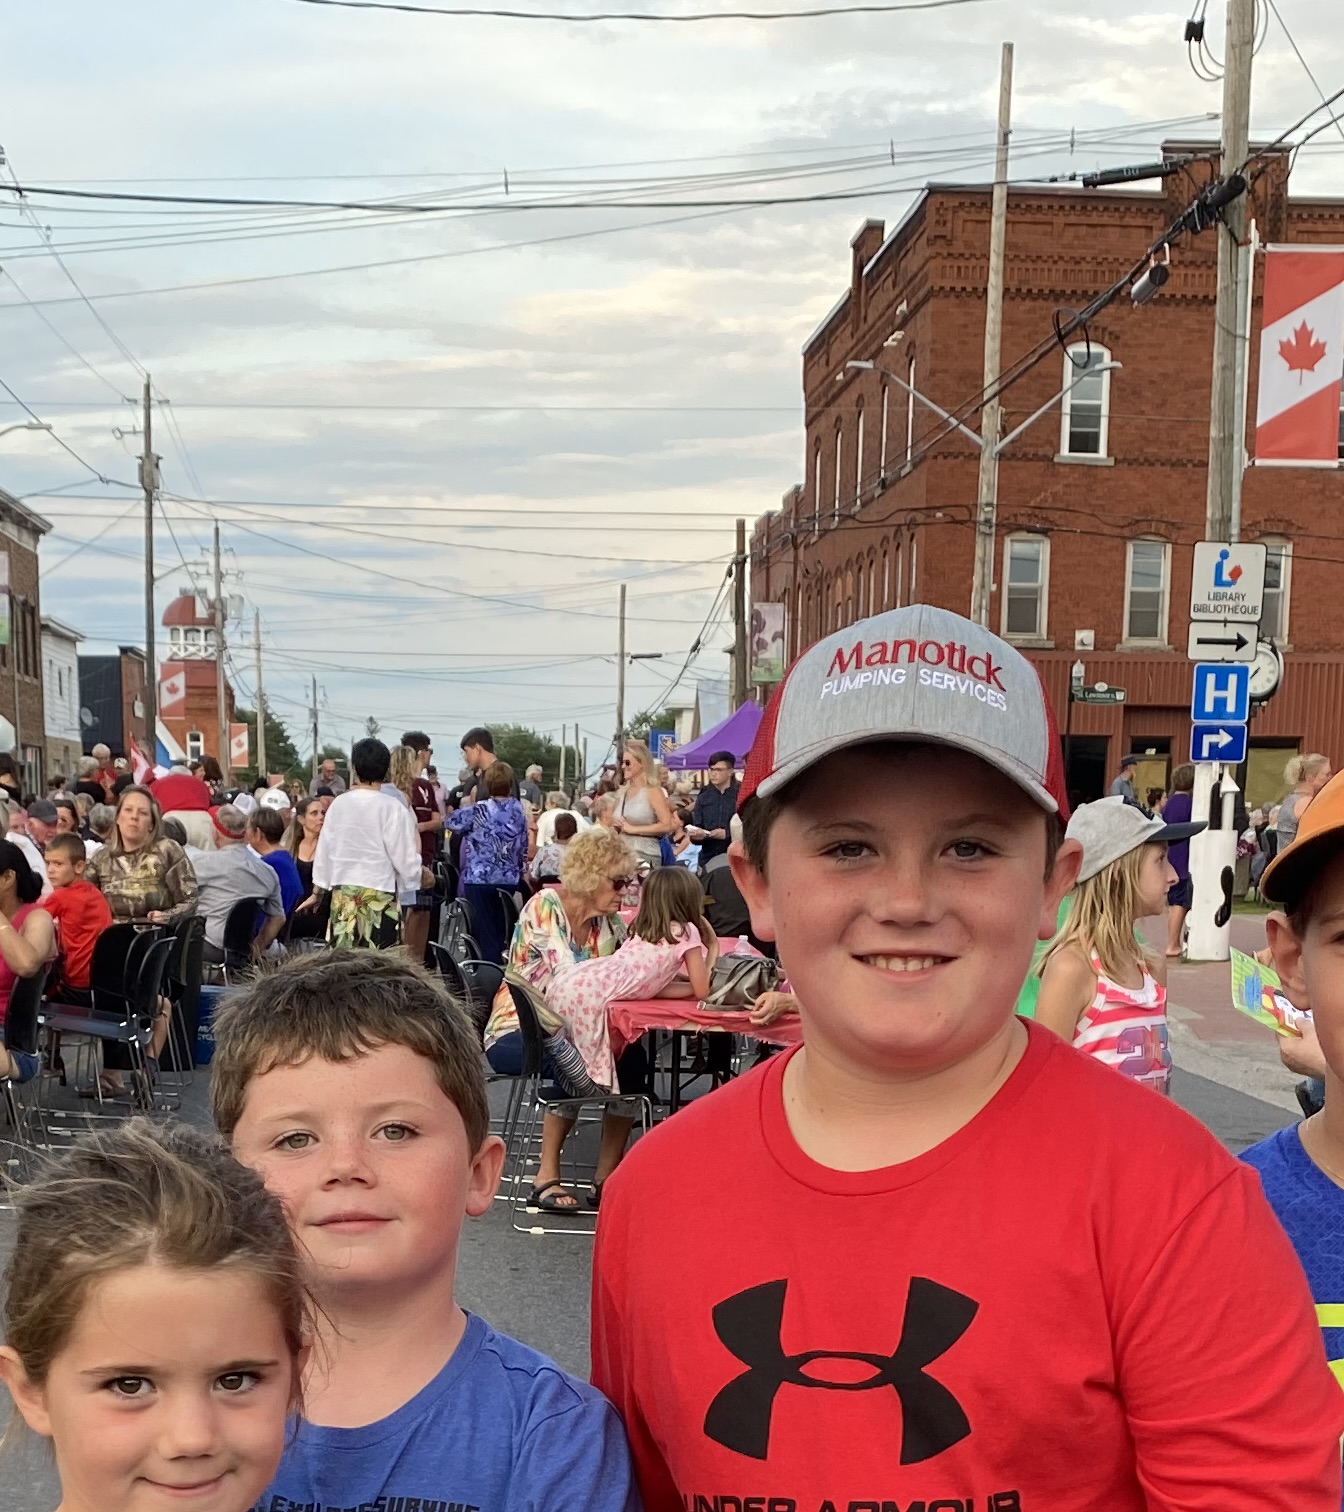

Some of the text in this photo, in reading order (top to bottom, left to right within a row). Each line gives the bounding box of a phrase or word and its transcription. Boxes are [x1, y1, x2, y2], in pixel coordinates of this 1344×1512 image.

[1207, 591, 1247, 602] LIBRARY
[820, 667, 1007, 712] PUMPING SERVICES
[826, 639, 1007, 692] Manotick
[1204, 672, 1238, 723] H
